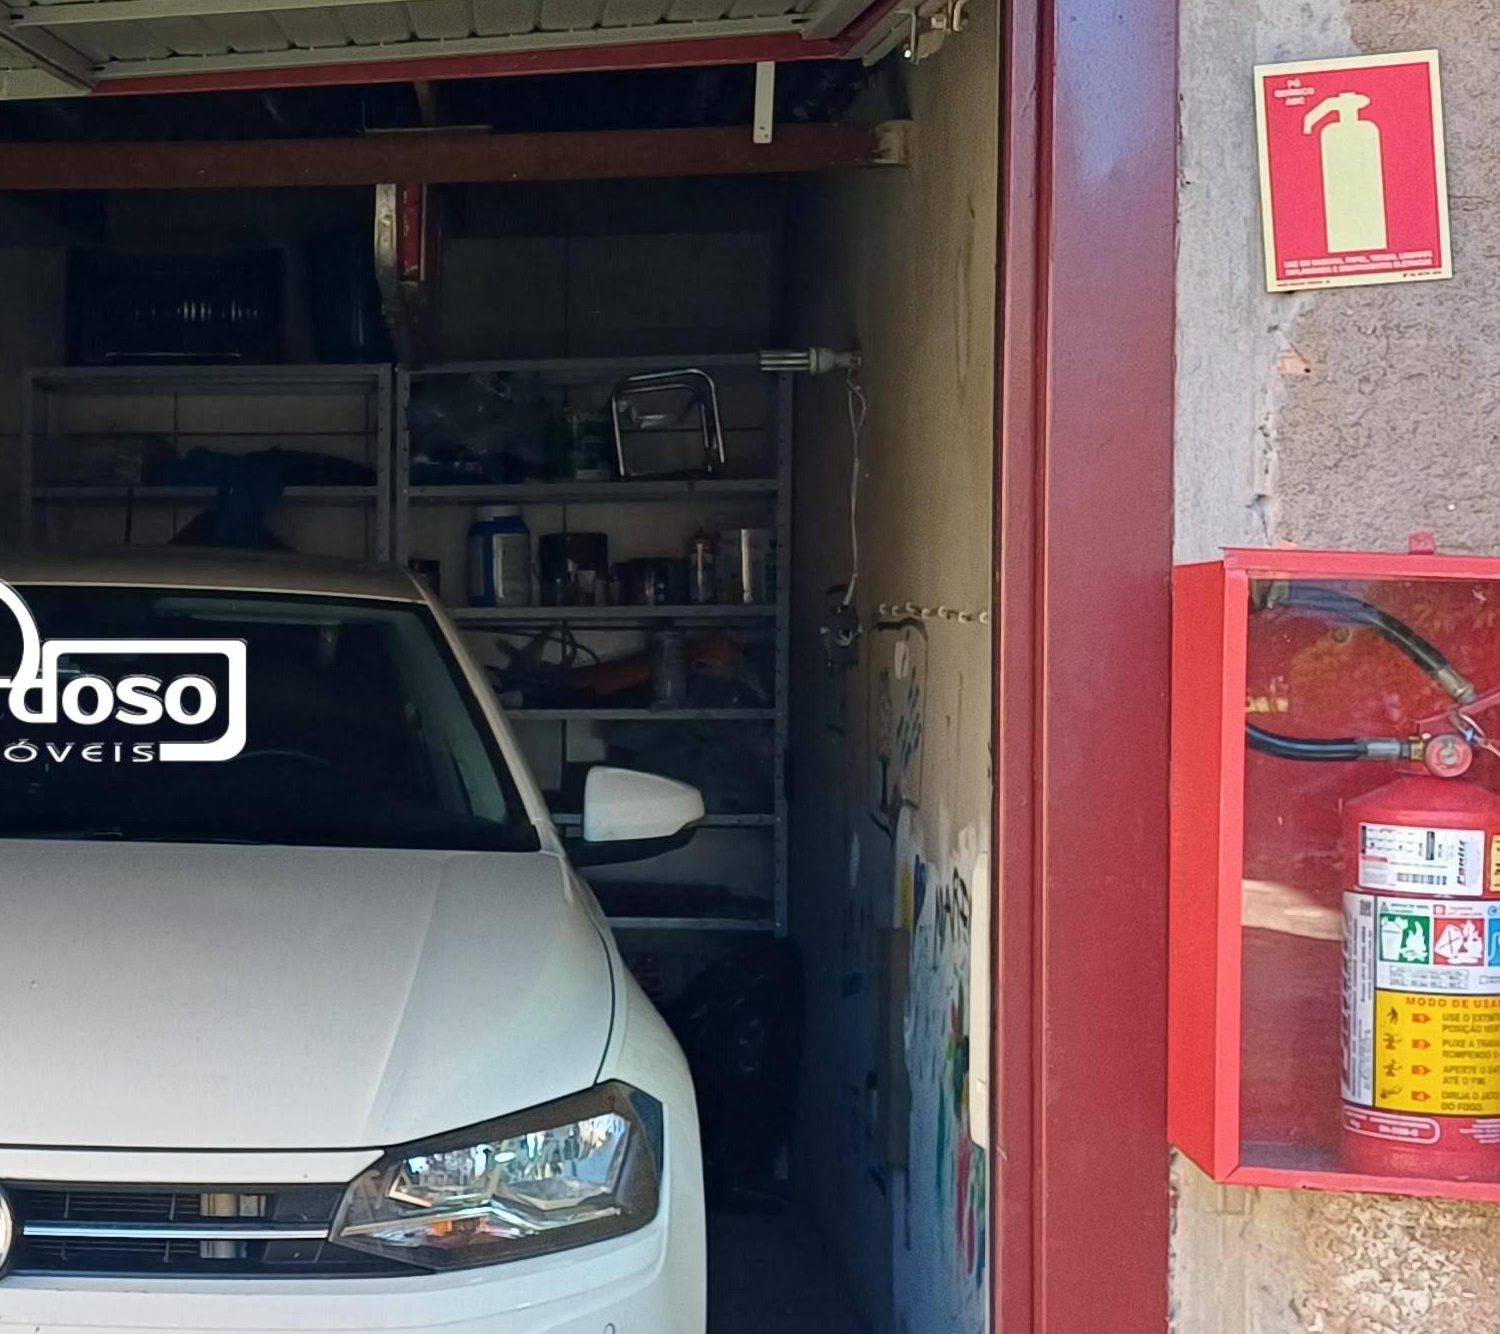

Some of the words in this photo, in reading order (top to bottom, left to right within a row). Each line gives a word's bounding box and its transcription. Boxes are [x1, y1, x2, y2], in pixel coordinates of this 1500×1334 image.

[1405, 997, 1446, 1007] MODO
[1452, 999, 1468, 1008] DE
[1474, 999, 1500, 1008] USA
